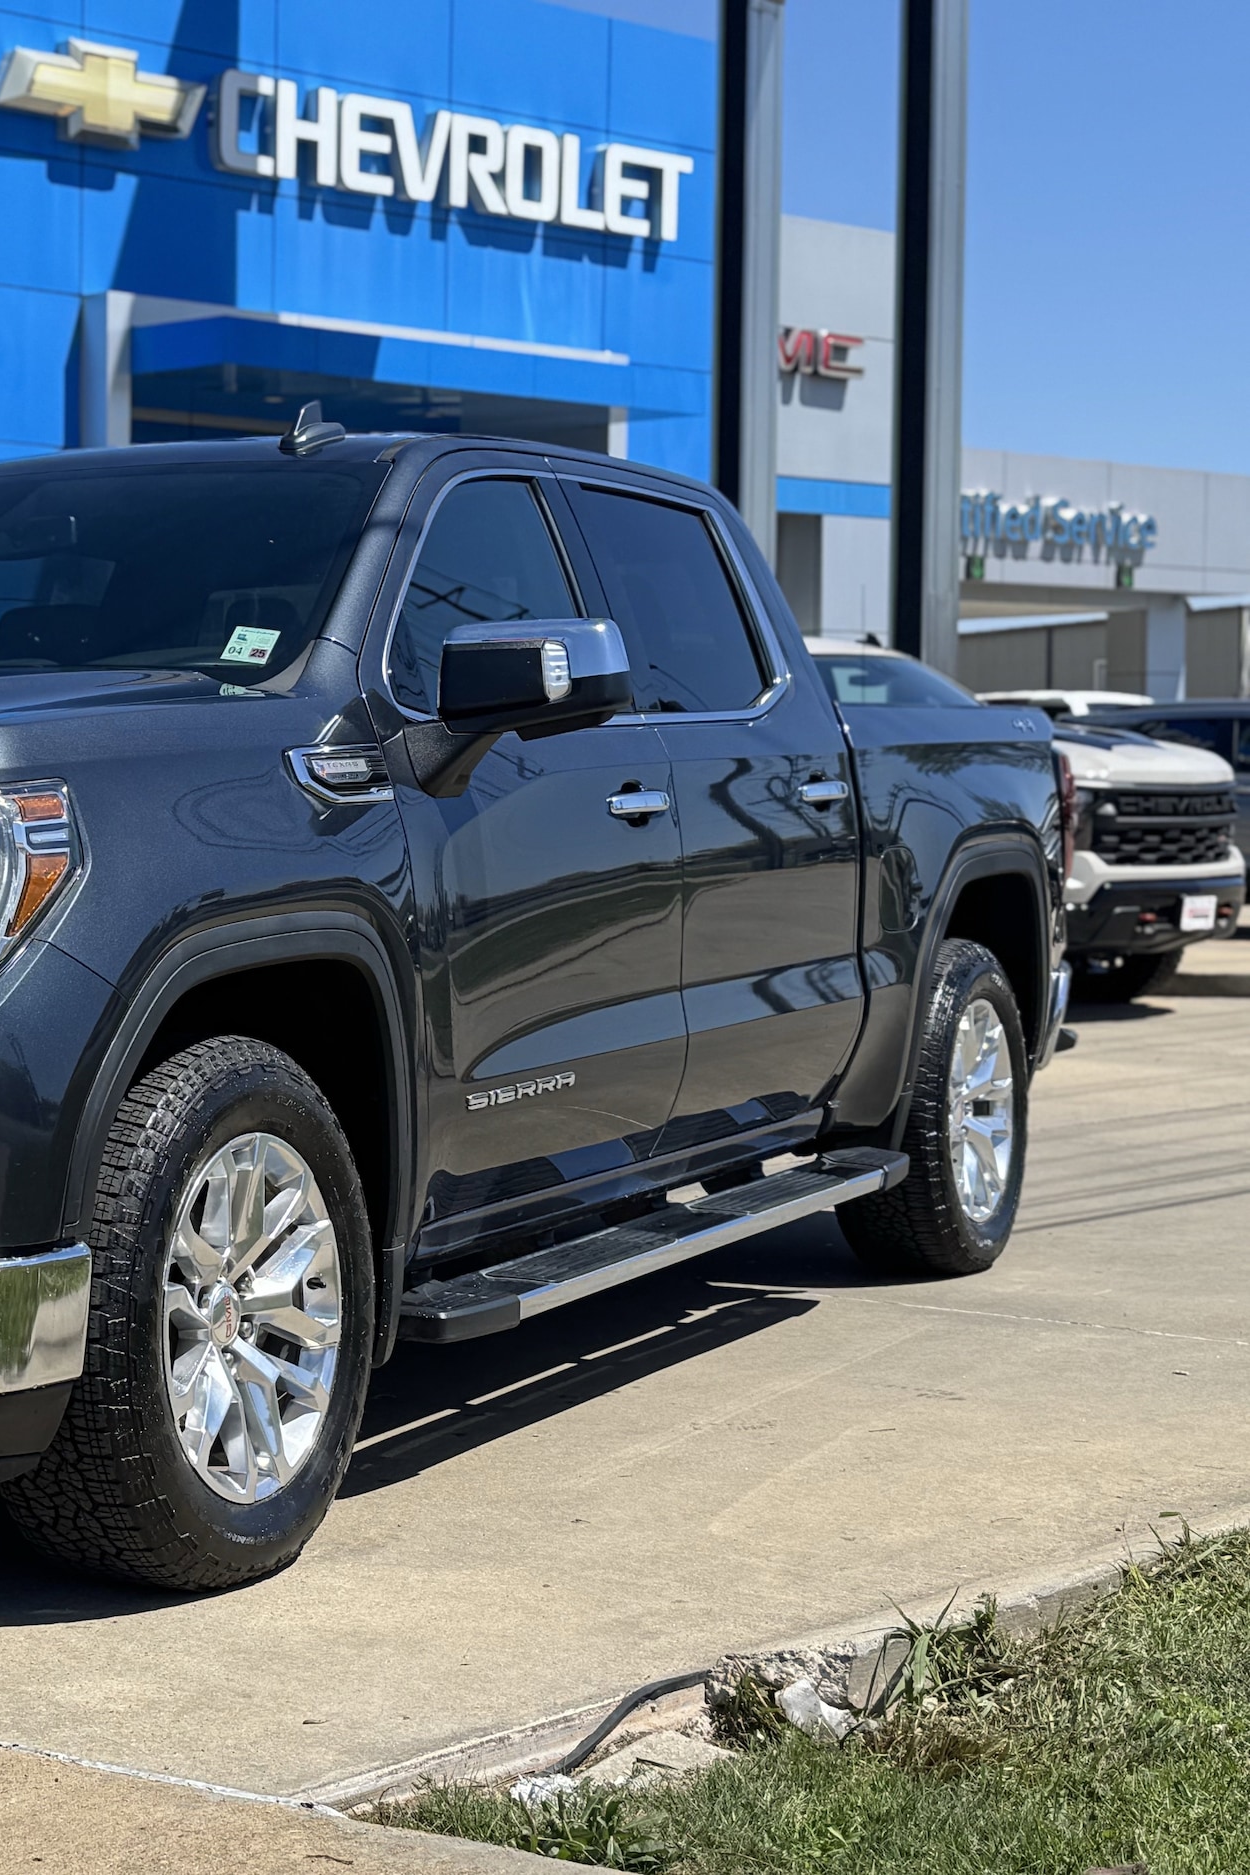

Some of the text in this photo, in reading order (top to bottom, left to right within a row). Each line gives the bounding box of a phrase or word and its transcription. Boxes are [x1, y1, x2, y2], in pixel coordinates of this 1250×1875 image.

[215, 68, 694, 241] CHEVROLET
[778, 328, 864, 379] MC
[960, 492, 1157, 549] tified Service
[228, 646, 266, 658] 04 25
[466, 1071, 576, 1111] SIERRA
